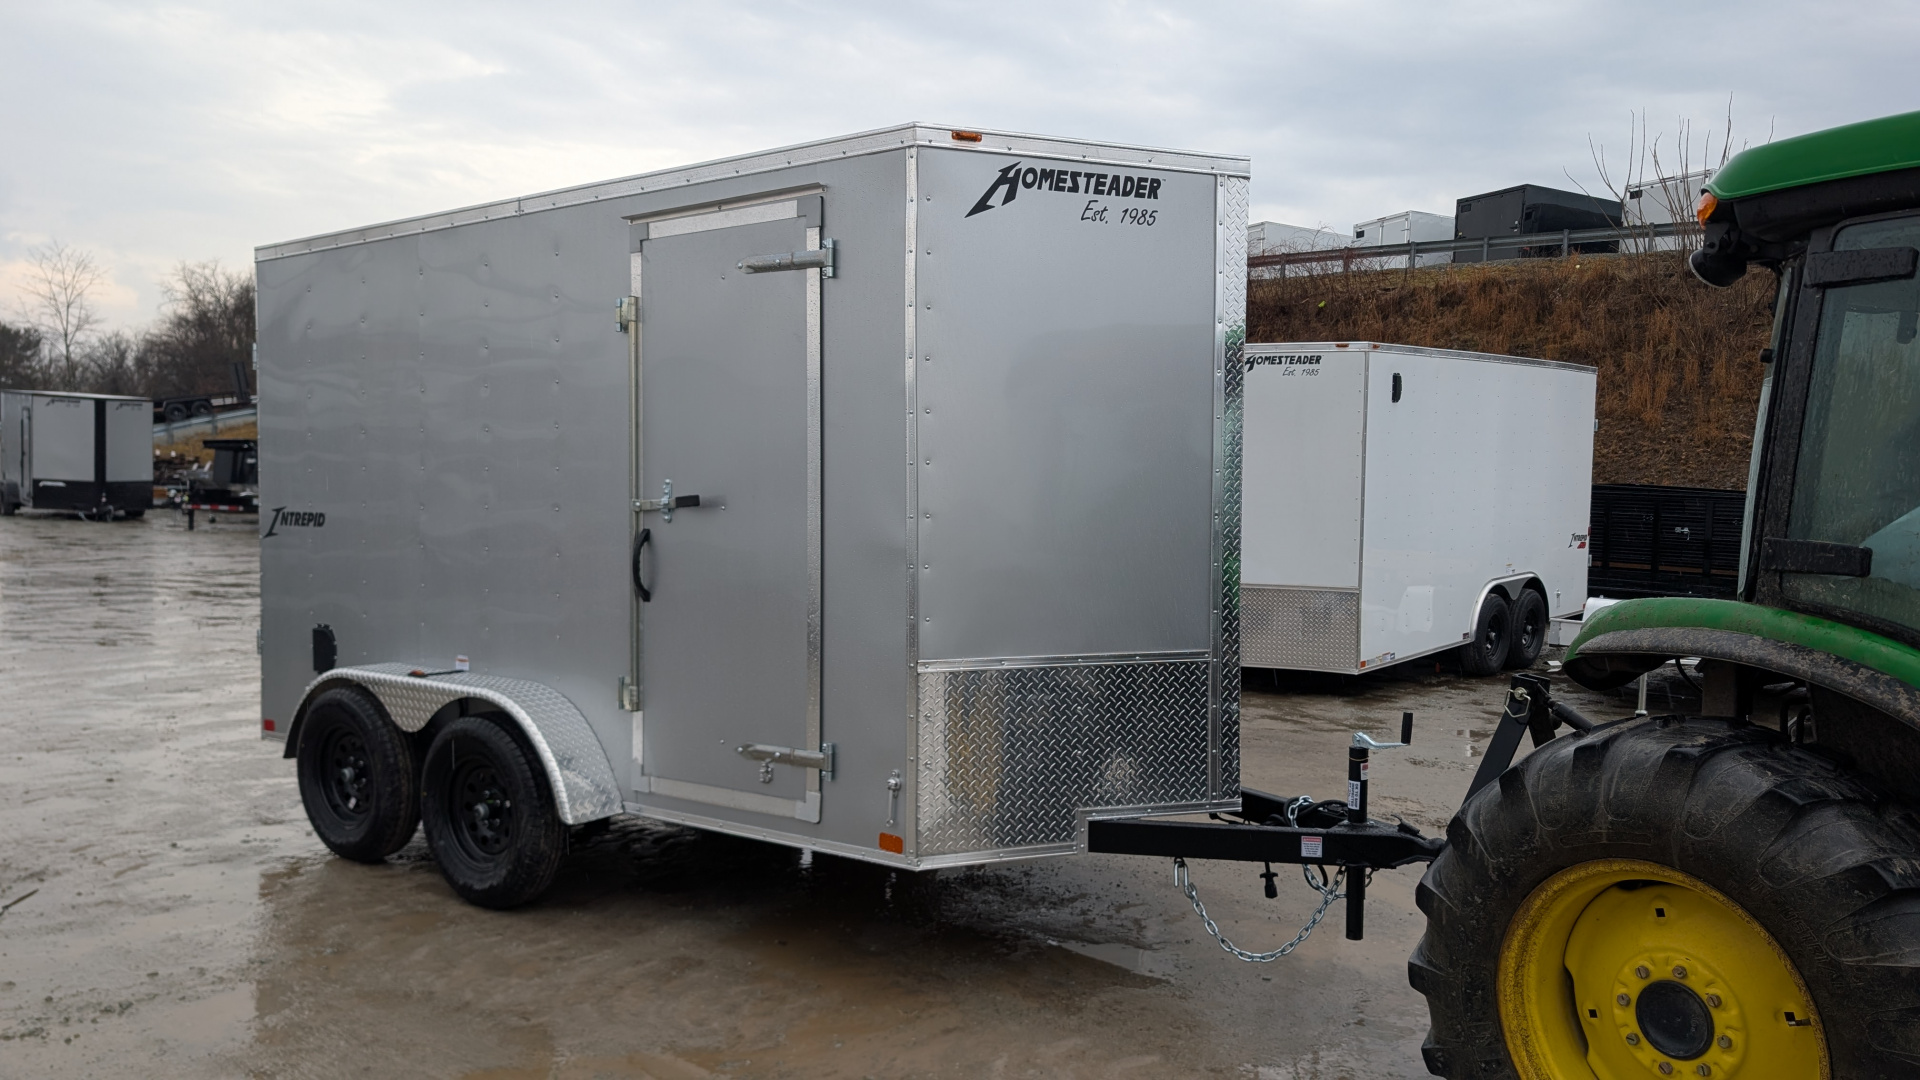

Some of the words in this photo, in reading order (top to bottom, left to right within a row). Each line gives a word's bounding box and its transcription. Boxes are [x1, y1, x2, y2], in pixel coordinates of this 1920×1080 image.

[963, 161, 1161, 218] HOMESTEADER
[1080, 200, 1109, 224] Est.
[1120, 208, 1158, 226] 1985
[1282, 366, 1296, 377] Est.
[1301, 368, 1320, 377] 1985
[263, 506, 326, 539] INTREPID
